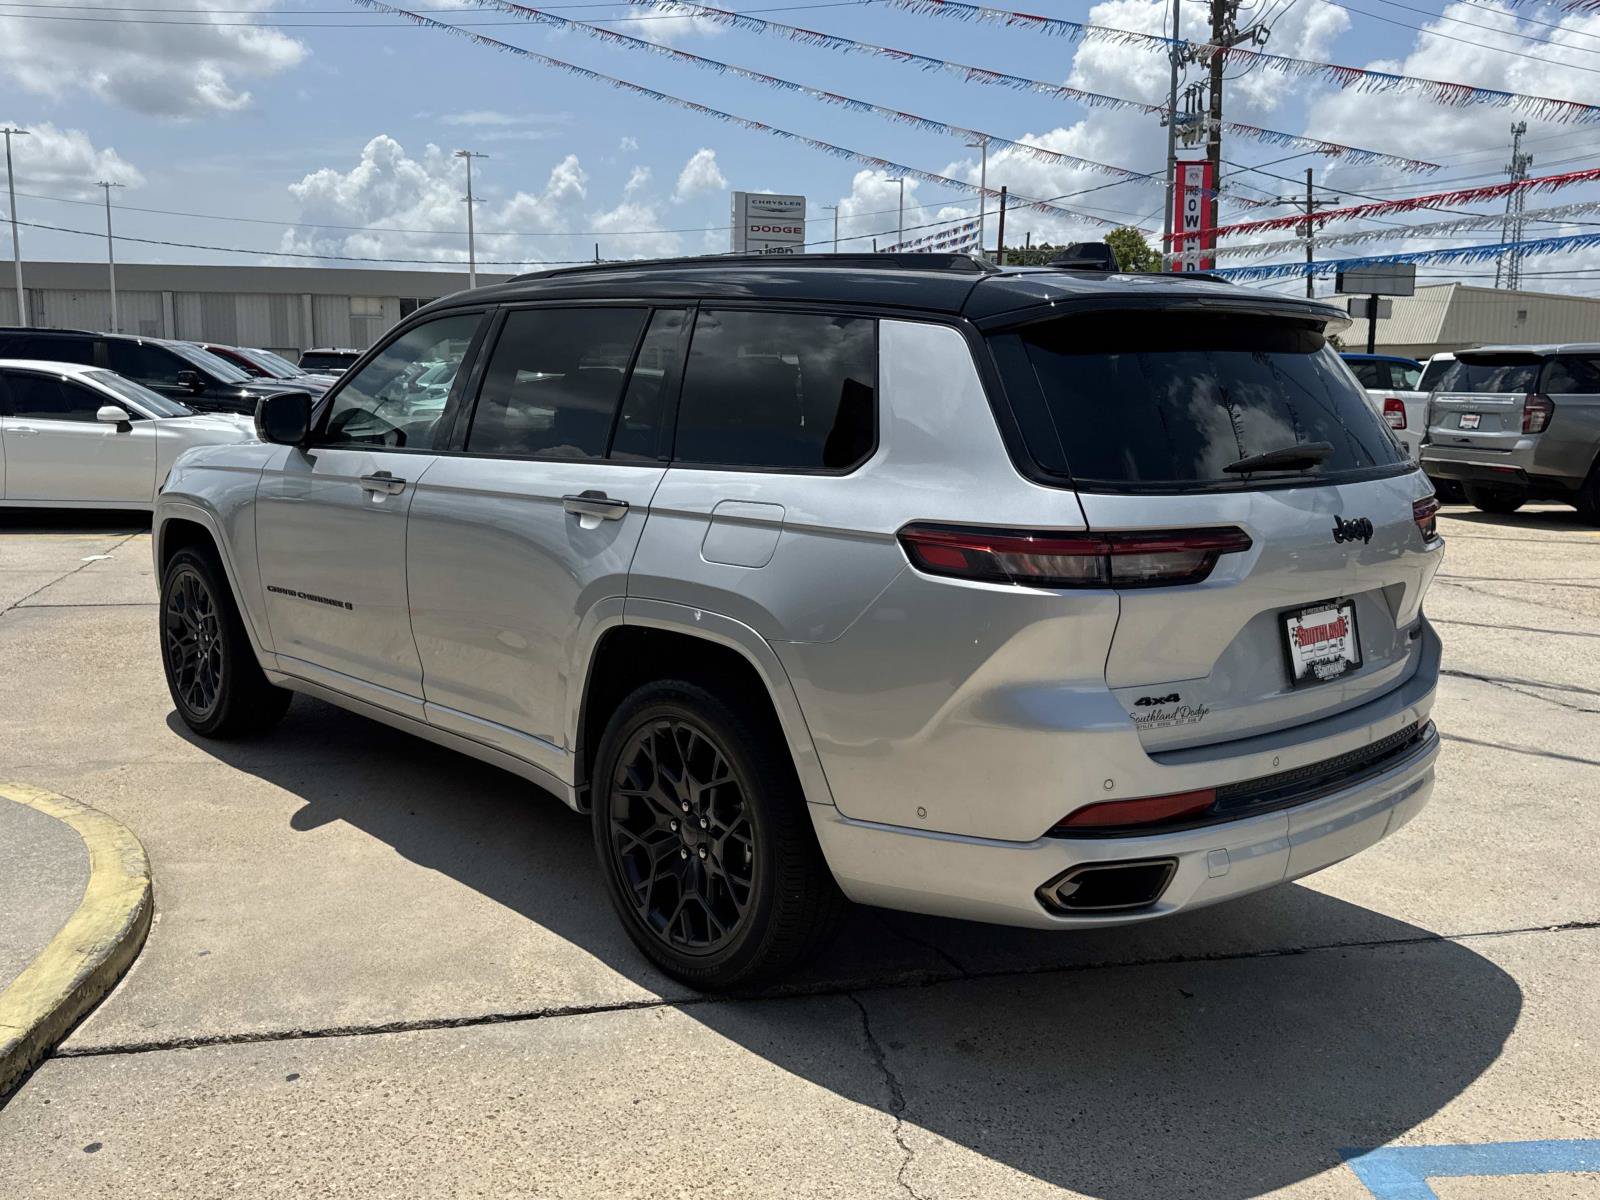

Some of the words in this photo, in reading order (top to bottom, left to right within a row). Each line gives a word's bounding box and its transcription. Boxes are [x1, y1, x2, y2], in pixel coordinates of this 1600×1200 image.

[752, 199, 801, 207] CHRYSLER
[751, 225, 802, 234] DODGE
[1332, 514, 1374, 544] Jeep
[1129, 706, 1179, 724] Southland
[1179, 703, 1209, 722] Dodge
